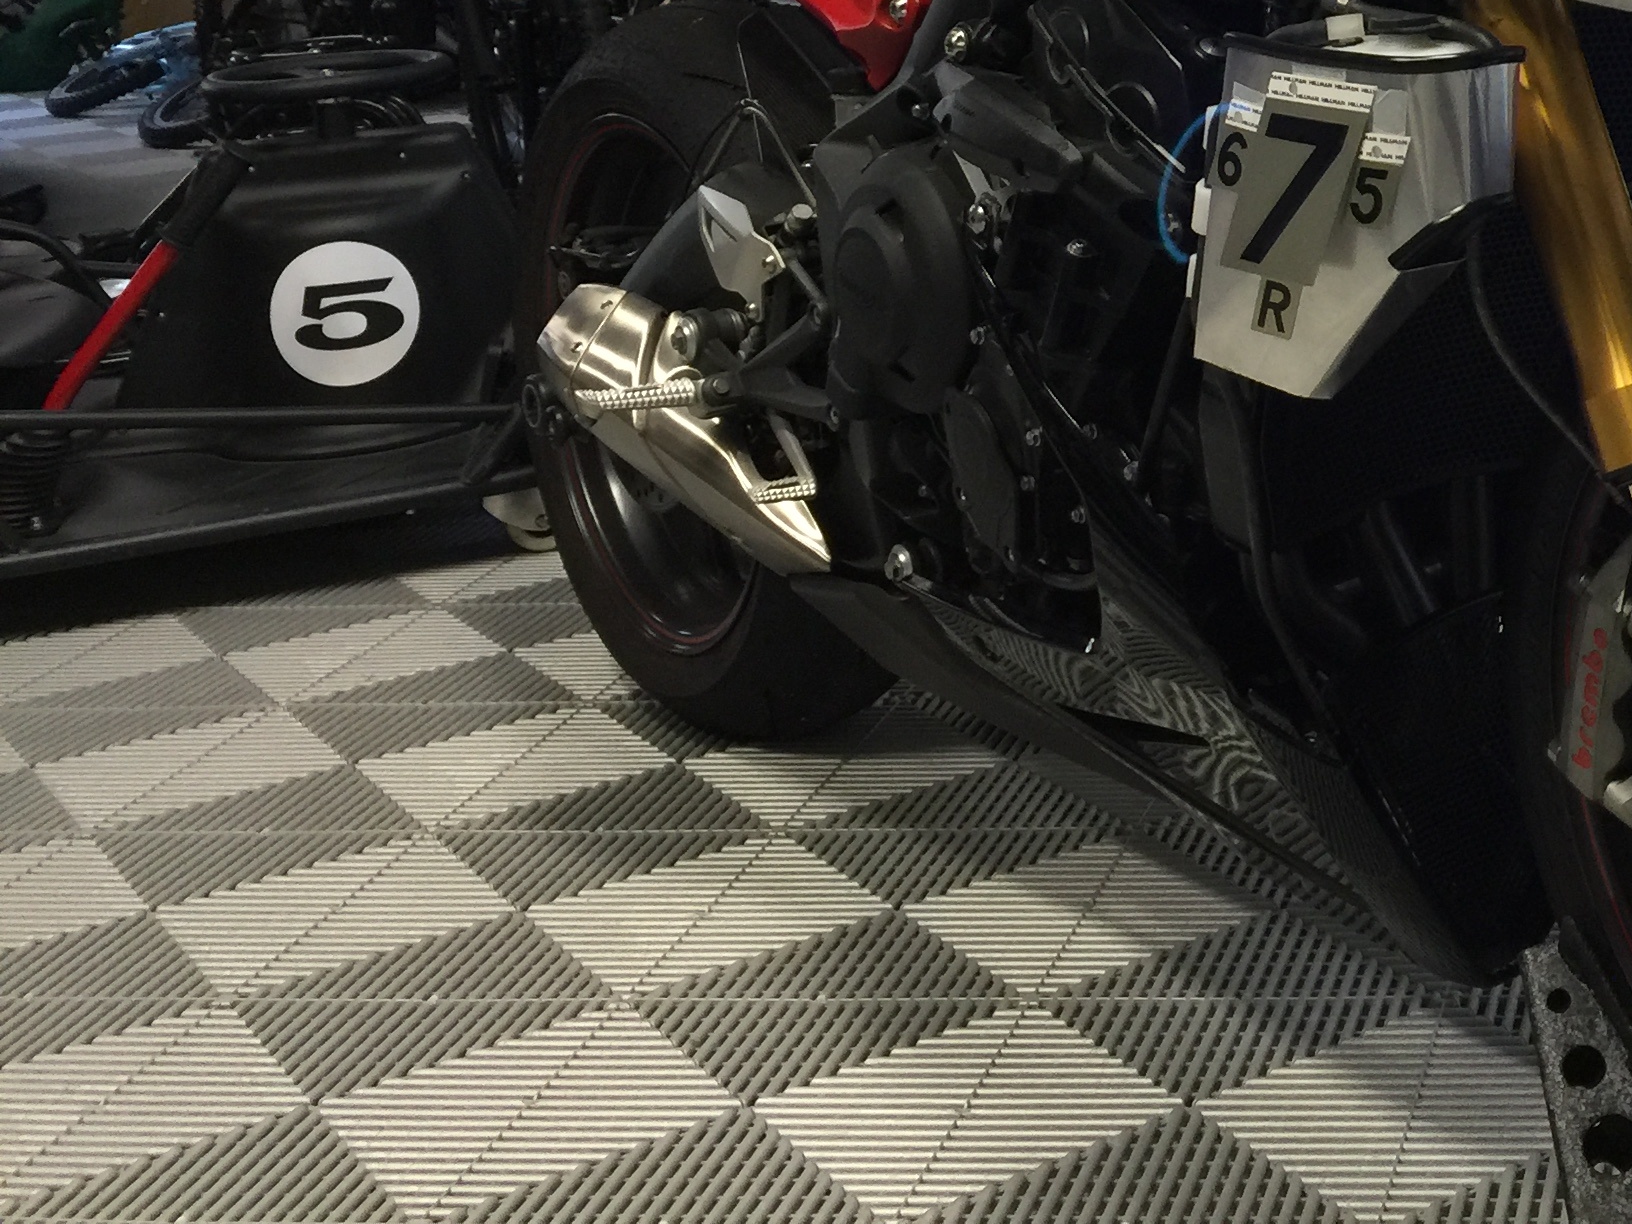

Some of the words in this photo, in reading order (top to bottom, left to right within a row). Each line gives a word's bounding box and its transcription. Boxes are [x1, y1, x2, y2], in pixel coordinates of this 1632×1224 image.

[1308, 79, 1333, 88] HILLMAN
[1334, 82, 1359, 92] HILLMAN
[1217, 132, 1248, 187] 6
[1240, 113, 1349, 265] 7
[1350, 168, 1389, 224] 5
[295, 276, 405, 351] 5
[1257, 280, 1291, 334] R
[1571, 627, 1608, 769] brembo
